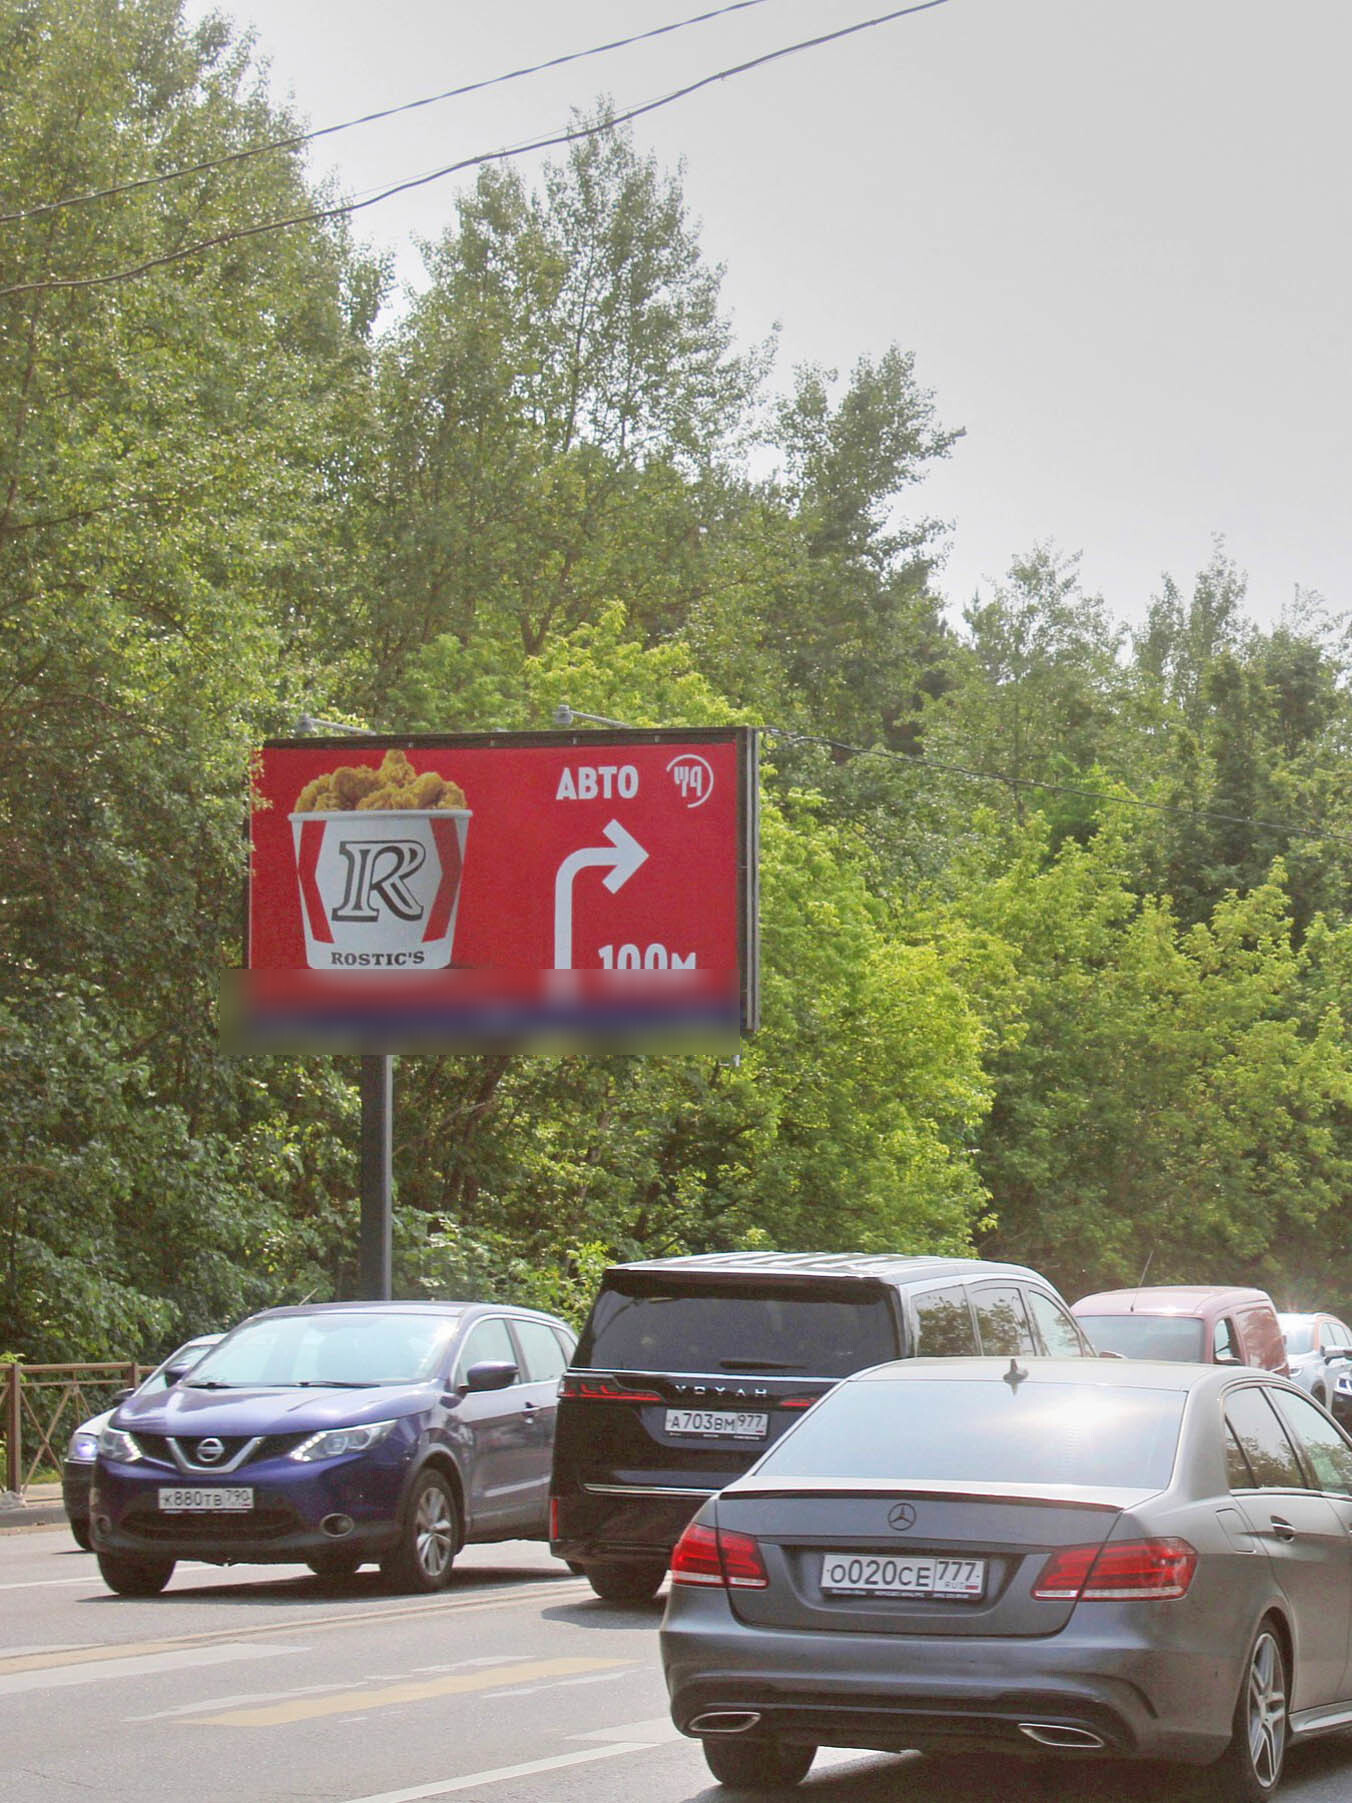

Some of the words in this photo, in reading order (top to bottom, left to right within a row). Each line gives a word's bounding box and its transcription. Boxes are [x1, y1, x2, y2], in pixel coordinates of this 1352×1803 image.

[555, 765, 639, 800] АВТО
[331, 840, 426, 922] R
[331, 951, 425, 966] ROSTIC'S
